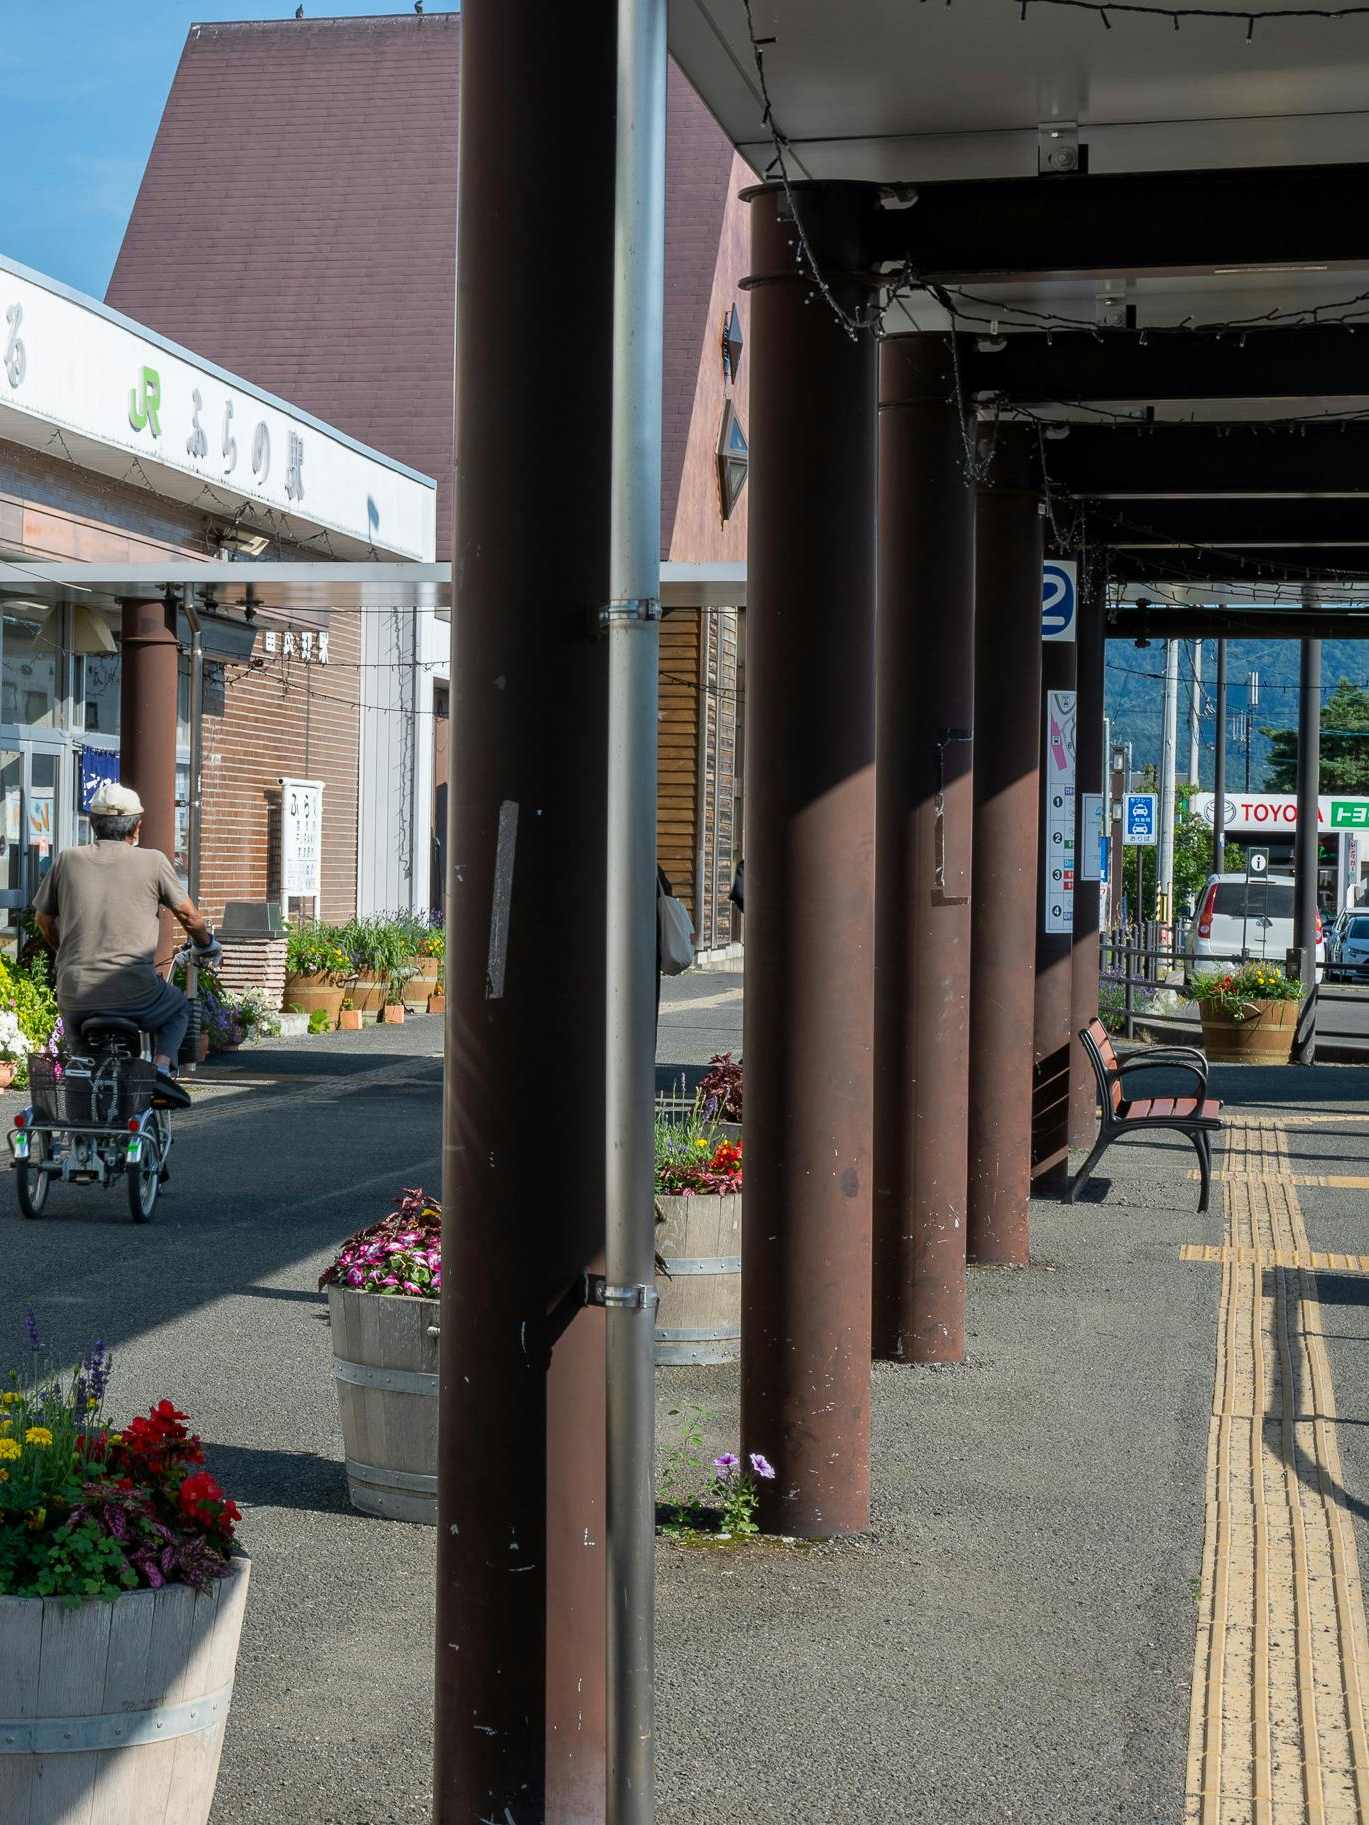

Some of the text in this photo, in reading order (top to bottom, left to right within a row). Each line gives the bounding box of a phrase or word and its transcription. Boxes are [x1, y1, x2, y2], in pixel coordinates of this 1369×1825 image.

[1042, 573, 1066, 626] 2
[1241, 803, 1324, 823] TOYO
[1336, 807, 1369, 823] トヨ
